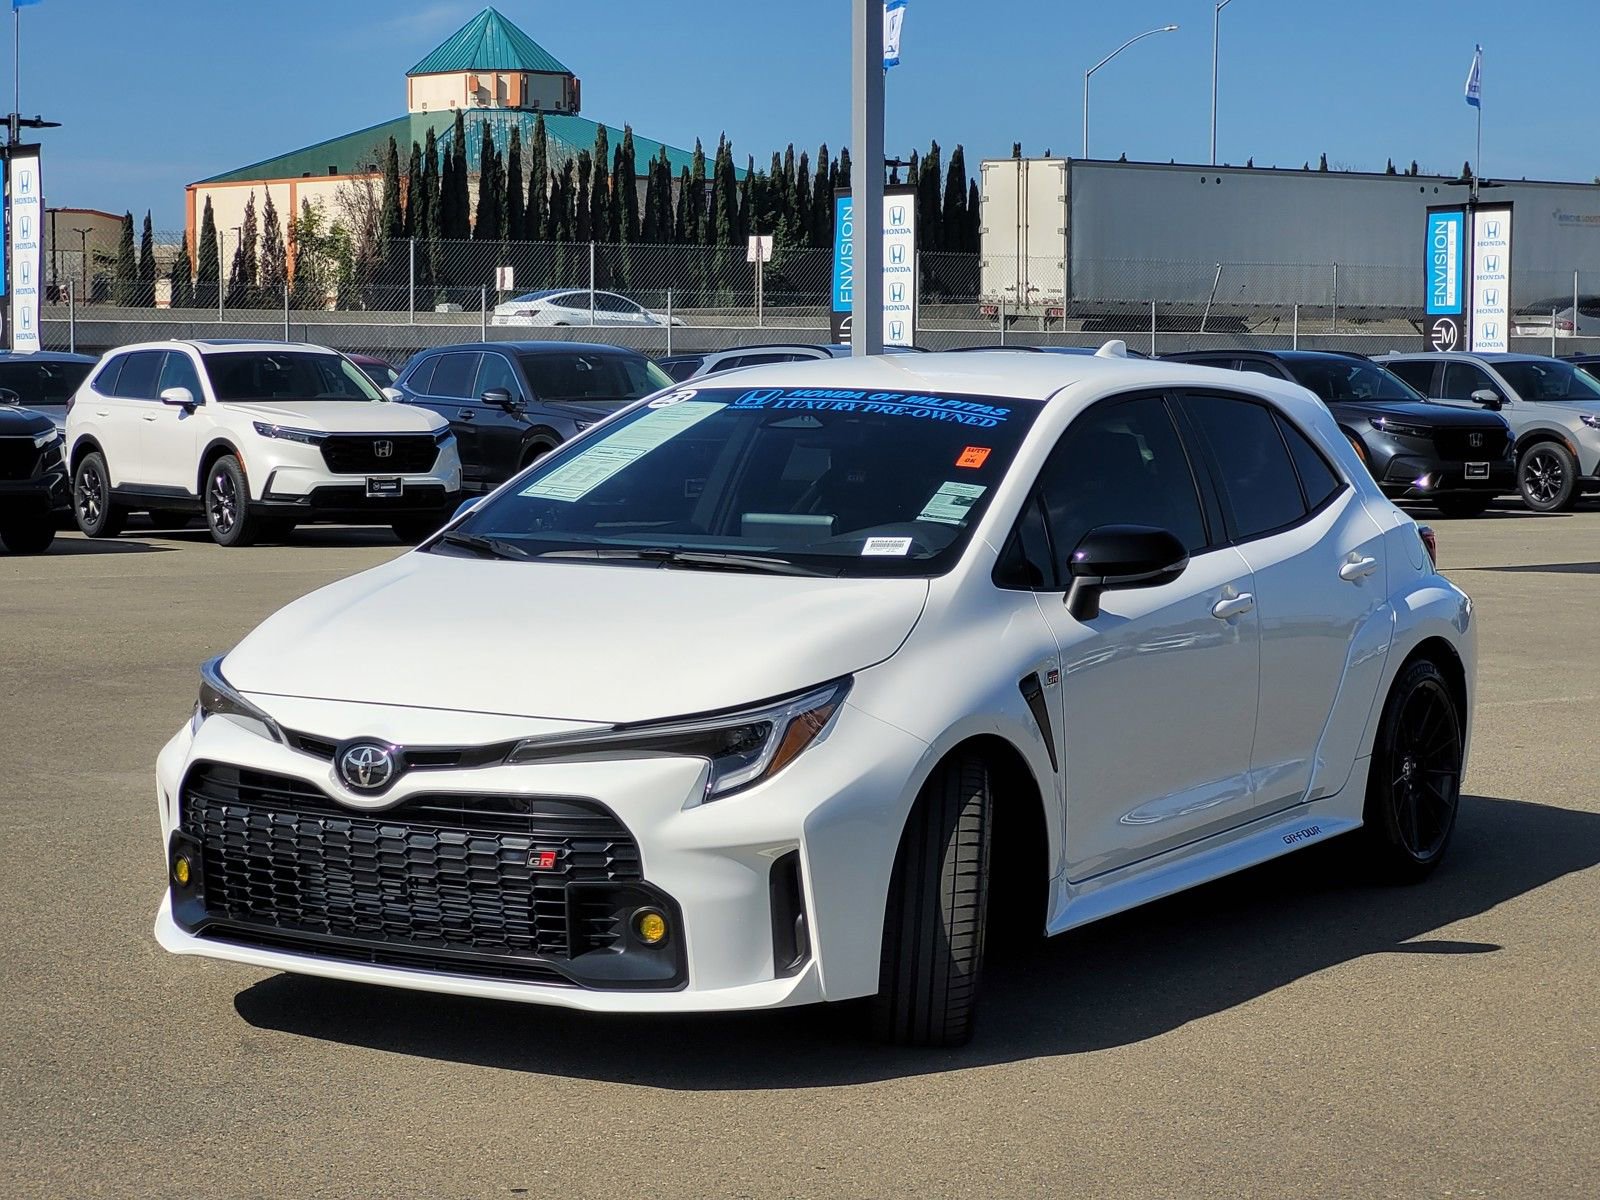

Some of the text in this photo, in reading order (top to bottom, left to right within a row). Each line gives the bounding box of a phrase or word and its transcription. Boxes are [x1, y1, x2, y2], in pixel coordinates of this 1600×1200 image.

[14, 197, 37, 205] HONDA
[15, 242, 37, 250] HONDA
[840, 206, 853, 302] ENVISION
[1434, 221, 1447, 306] ENVISION
[772, 400, 998, 428] LUXURY PRE-OWNED
[785, 389, 1011, 416] HONDA OF MILPITAS
[528, 857, 554, 866] GR
